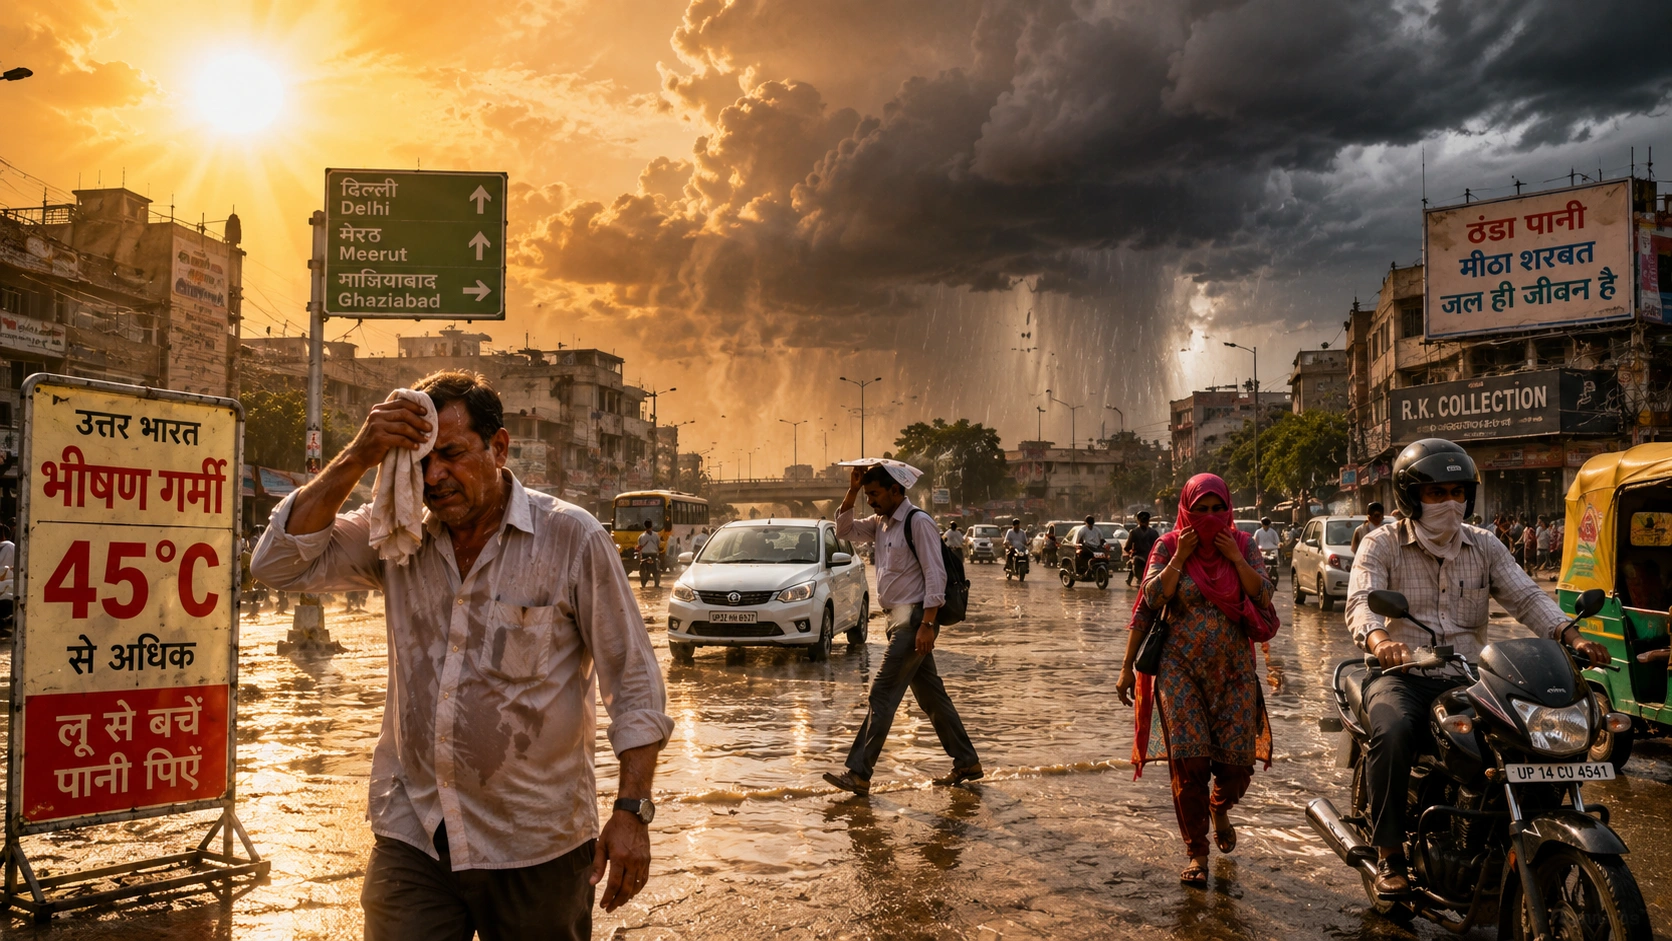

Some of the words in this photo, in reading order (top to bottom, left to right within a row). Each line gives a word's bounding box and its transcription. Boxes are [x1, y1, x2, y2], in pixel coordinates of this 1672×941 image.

[340, 177, 399, 198] दिल्ली
[340, 200, 390, 216] Delhi
[1466, 214, 1517, 244] ठंडा
[1523, 199, 1588, 235] पानी
[339, 222, 382, 243] मेरठ
[339, 246, 408, 262] Meerut
[1458, 249, 1513, 278] मीठा
[1520, 240, 1597, 272] शरबत
[338, 292, 441, 309] Ghaziabad
[1440, 291, 1484, 314] जल
[1490, 280, 1516, 313] ही
[1521, 276, 1592, 305] जीवन
[1597, 266, 1619, 300] है
[1401, 398, 1434, 421] R.K.
[1438, 385, 1547, 417] COLLECTION
[75, 409, 132, 440] उत्तर
[140, 416, 202, 446] भारत
[41, 445, 152, 511] भीषण
[158, 457, 228, 514] गर्मी
[43, 539, 220, 620] 45°C
[66, 634, 98, 675] से
[108, 632, 197, 672] अधिक
[56, 713, 96, 758] लू
[103, 699, 137, 743] से
[148, 695, 204, 738] बचें
[54, 751, 133, 799] पानी
[1517, 766, 1535, 780] UP
[1538, 766, 1554, 779] 14
[1557, 765, 1574, 779] CU
[1577, 764, 1608, 779] 4541
